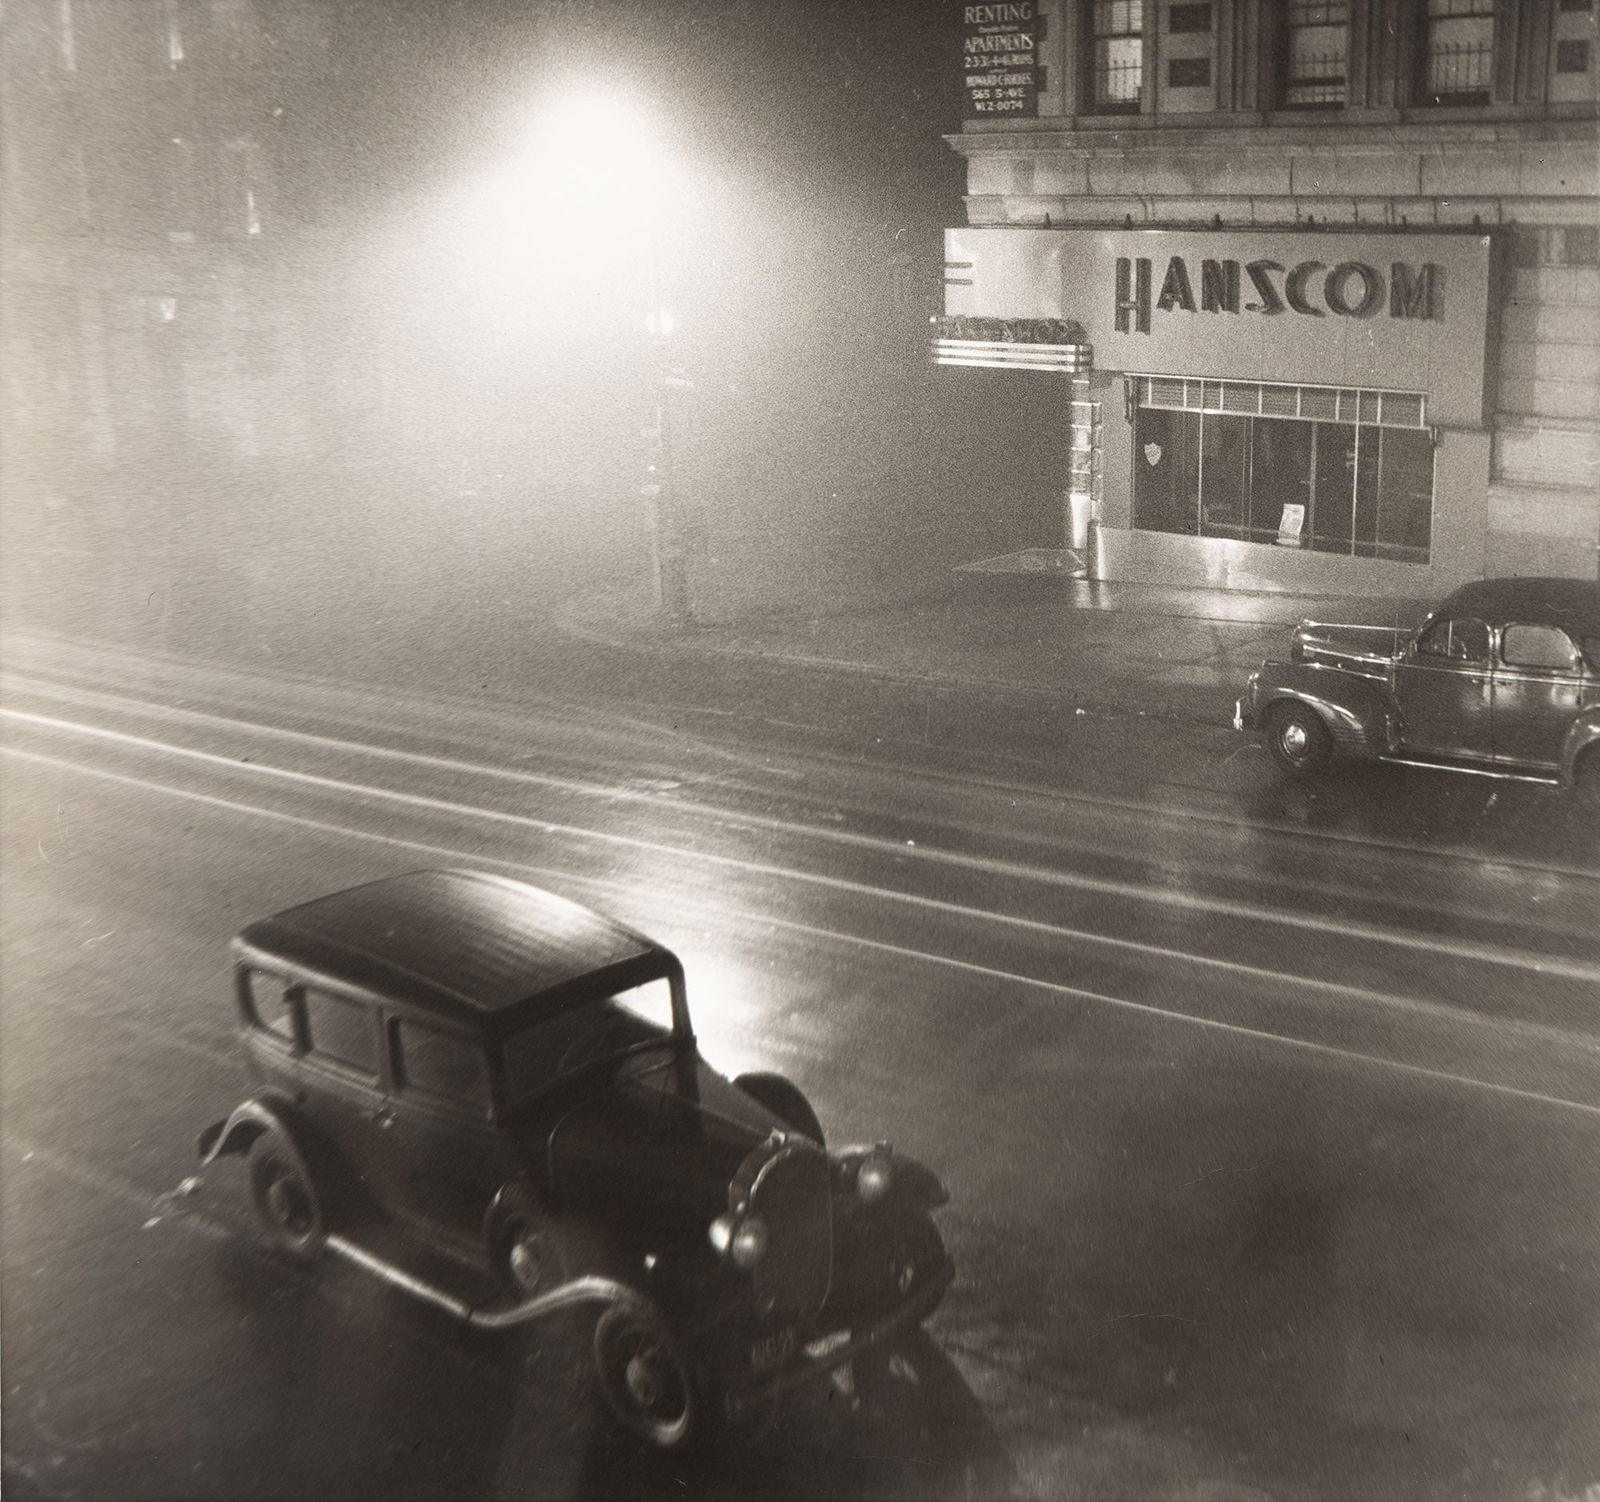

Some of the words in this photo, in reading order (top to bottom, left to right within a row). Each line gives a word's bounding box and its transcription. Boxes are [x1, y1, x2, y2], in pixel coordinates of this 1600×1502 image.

[964, 2, 1032, 24] RENTING
[963, 33, 1034, 53] APARTMENTS
[1114, 256, 1446, 334] HANSCOM
